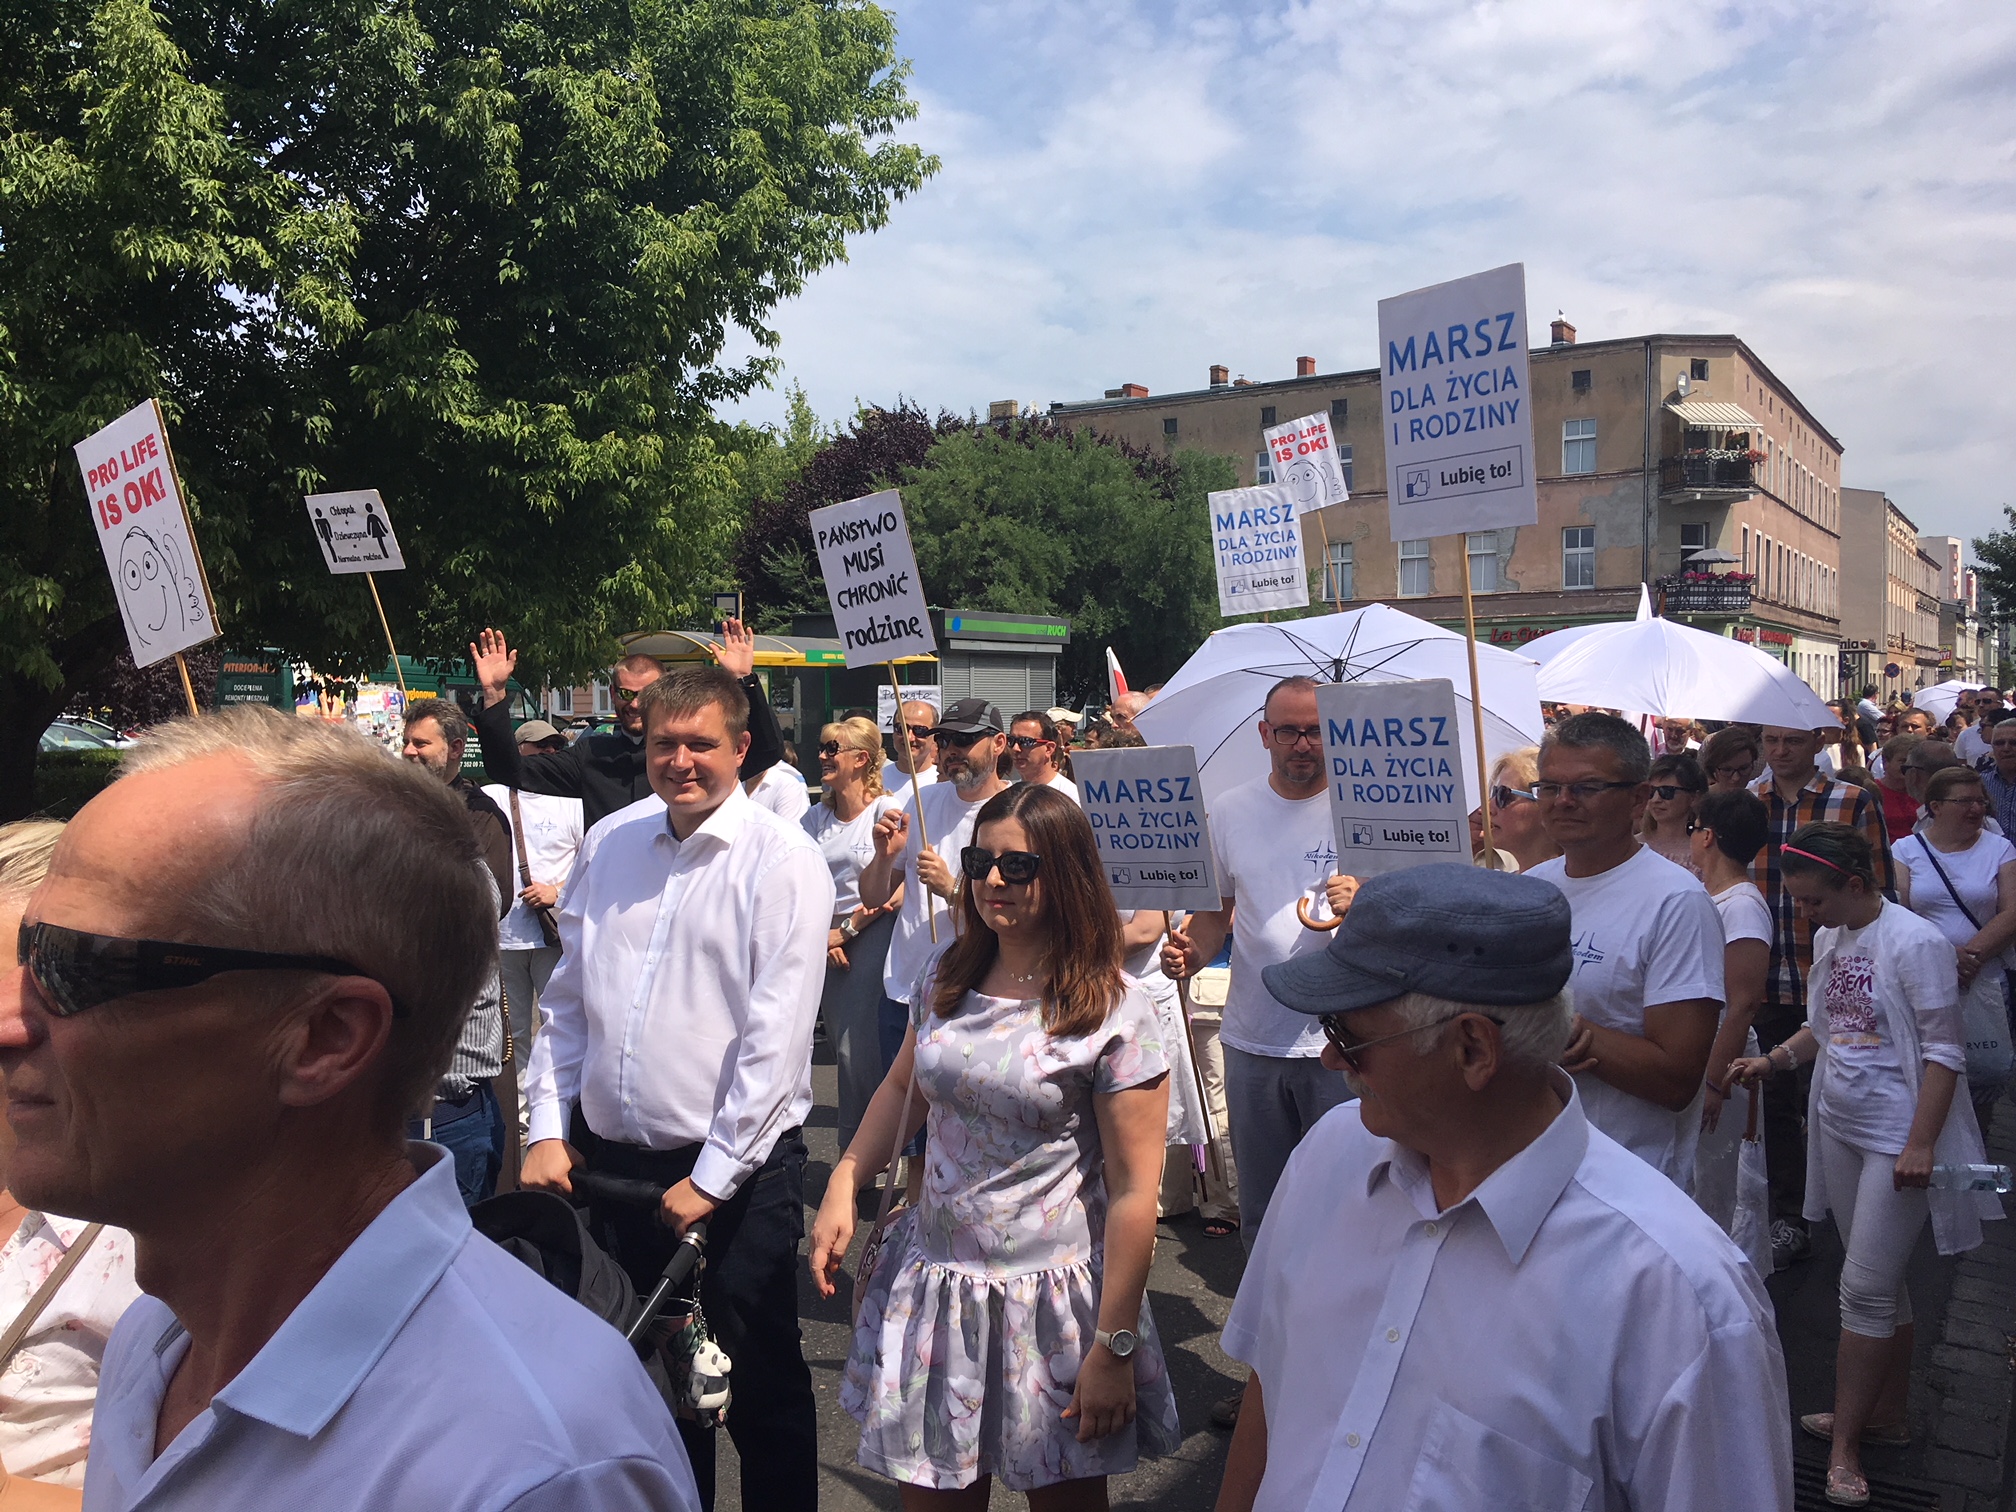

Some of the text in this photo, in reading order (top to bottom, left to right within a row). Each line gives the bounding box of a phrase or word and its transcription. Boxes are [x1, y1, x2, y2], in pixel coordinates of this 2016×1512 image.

[1388, 311, 1517, 376] MARSZ
[1390, 365, 1519, 414] DLA ŻYCIA
[1393, 398, 1520, 446] I RODZINY
[1269, 423, 1327, 449] PRO LIFE
[1274, 435, 1329, 463] IS OK!
[87, 432, 159, 493] PRO LIFE
[1440, 460, 1512, 488] Lubię to!
[98, 467, 167, 531] IS OK!
[1216, 503, 1295, 532] MARSZ
[1218, 528, 1297, 552] DLA ŻYCIA
[1221, 544, 1299, 568] I RODZINY
[1251, 574, 1295, 590] Lubię to!
[844, 614, 924, 650] rodzinę
[1048, 625, 1067, 637] RUCH
[1328, 717, 1450, 747] MARSZ
[1333, 752, 1453, 778] DLA ŻYCIA
[1084, 776, 1194, 804] MARSZ
[1337, 783, 1455, 804] I RODZINY
[1091, 807, 1198, 828] DLA ŻYCIA
[1096, 831, 1201, 850] I RODZINY
[1383, 828, 1450, 845] Lubię to!
[1139, 868, 1199, 883] Lubię to!
[163, 955, 202, 966] STIHL
[1572, 948, 1604, 961] kodem
[1966, 1041, 1998, 1050] RVED
